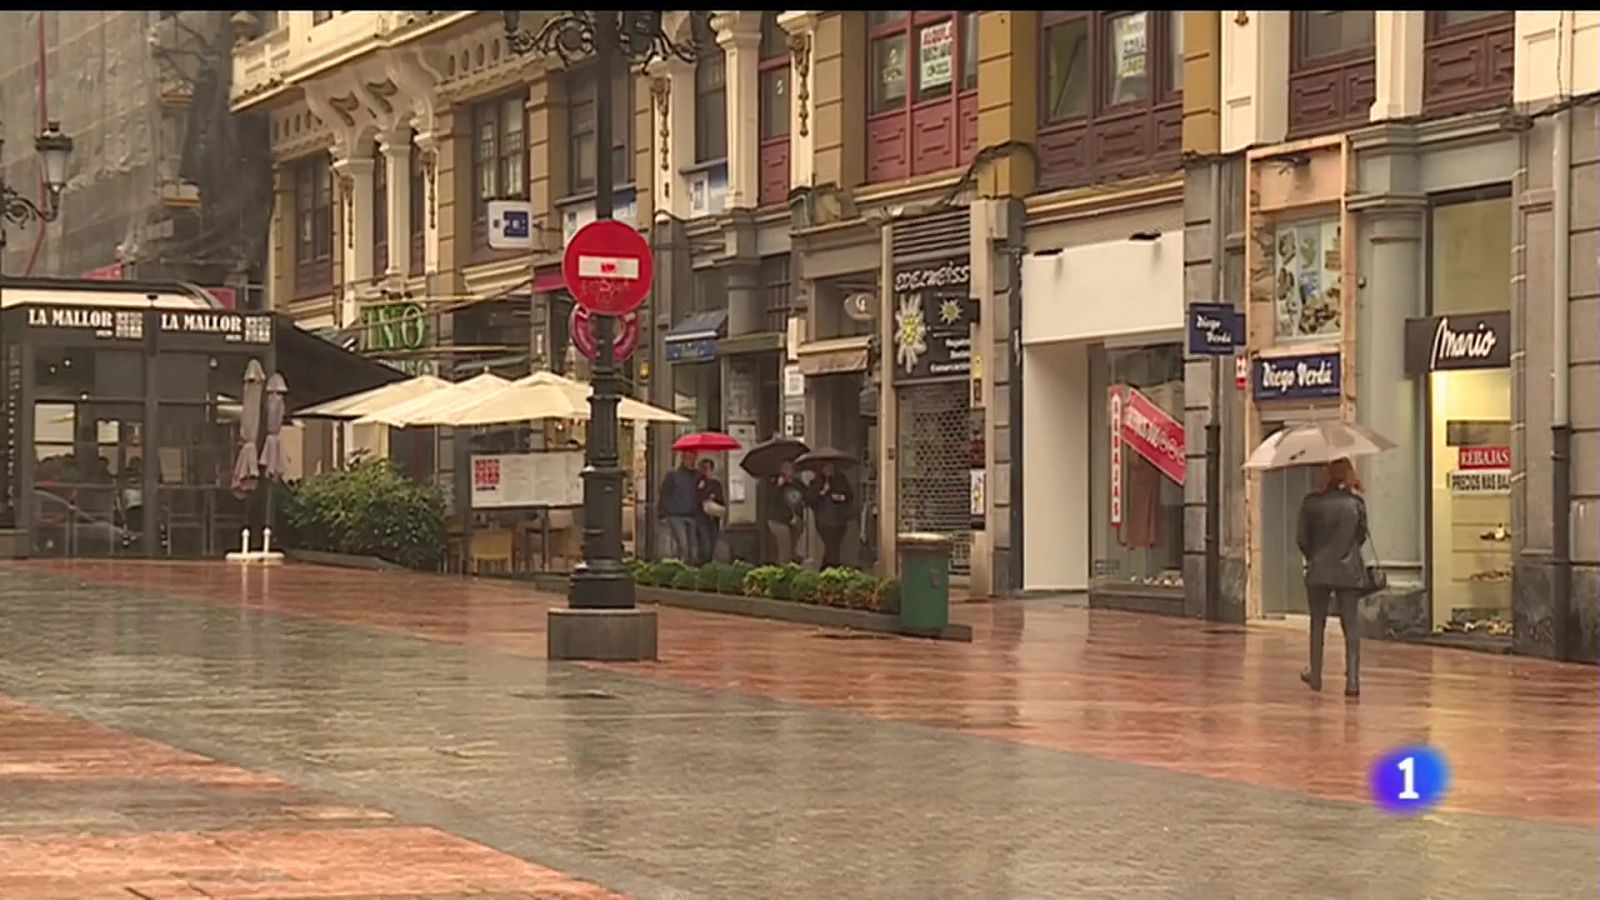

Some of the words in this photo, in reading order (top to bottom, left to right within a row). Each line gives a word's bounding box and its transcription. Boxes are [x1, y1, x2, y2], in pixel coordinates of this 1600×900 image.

[28, 309, 48, 325] LA
[52, 311, 113, 328] MALLOR
[161, 314, 180, 330] LA
[183, 316, 242, 332] MALLOR
[1430, 317, 1496, 368] Mario
[1262, 362, 1296, 392] Diego
[1460, 449, 1509, 467] REBAJAS
